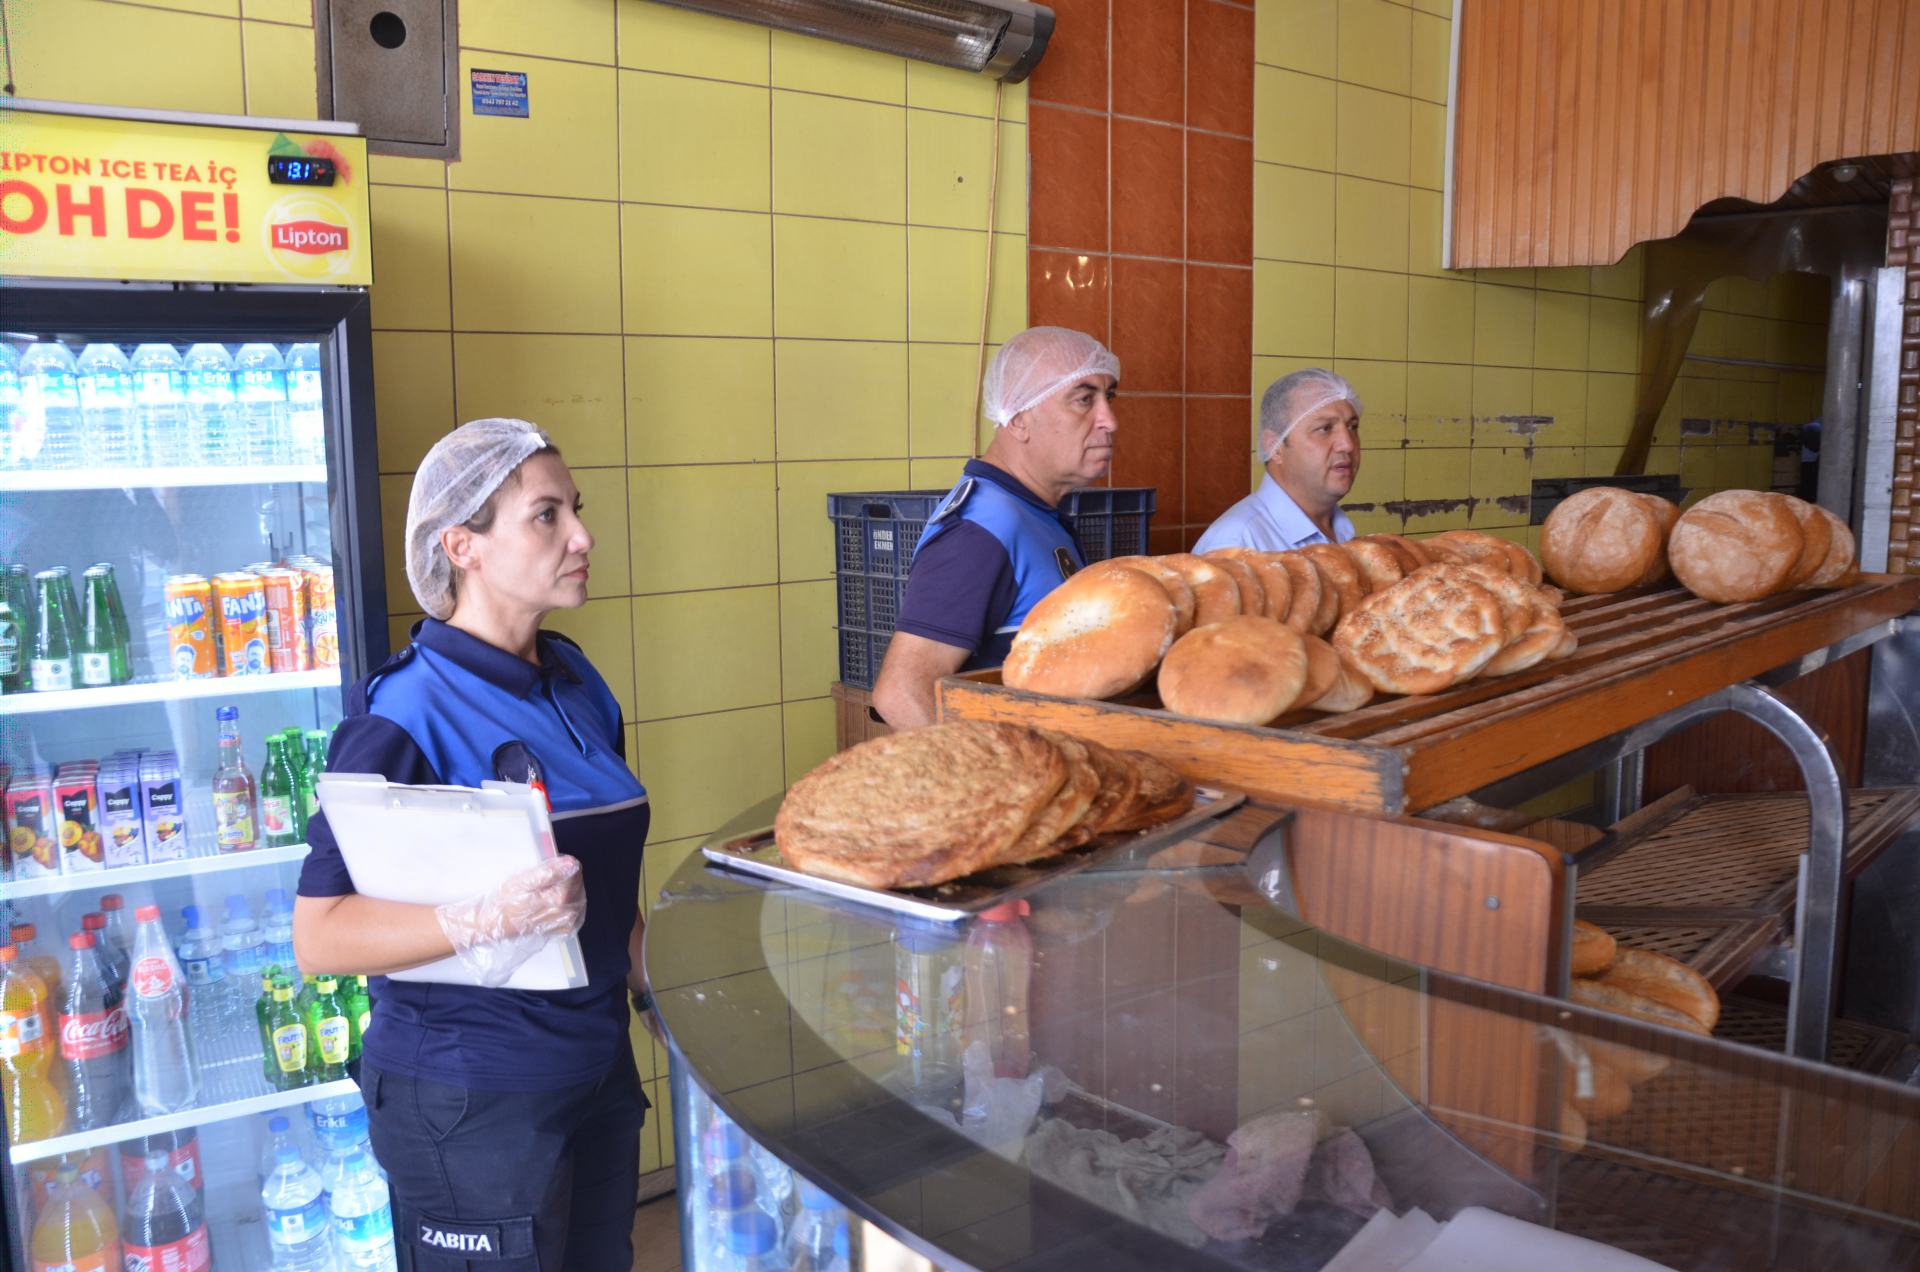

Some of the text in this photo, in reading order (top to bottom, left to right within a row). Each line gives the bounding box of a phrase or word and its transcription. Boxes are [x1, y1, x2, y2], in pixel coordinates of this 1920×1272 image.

[100, 159, 146, 179] ICE
[153, 162, 201, 182] TEA
[208, 160, 237, 189] İÇ
[0, 178, 240, 243] OH DE!
[278, 227, 342, 248] Lipton
[421, 1225, 492, 1252] ZABITA
